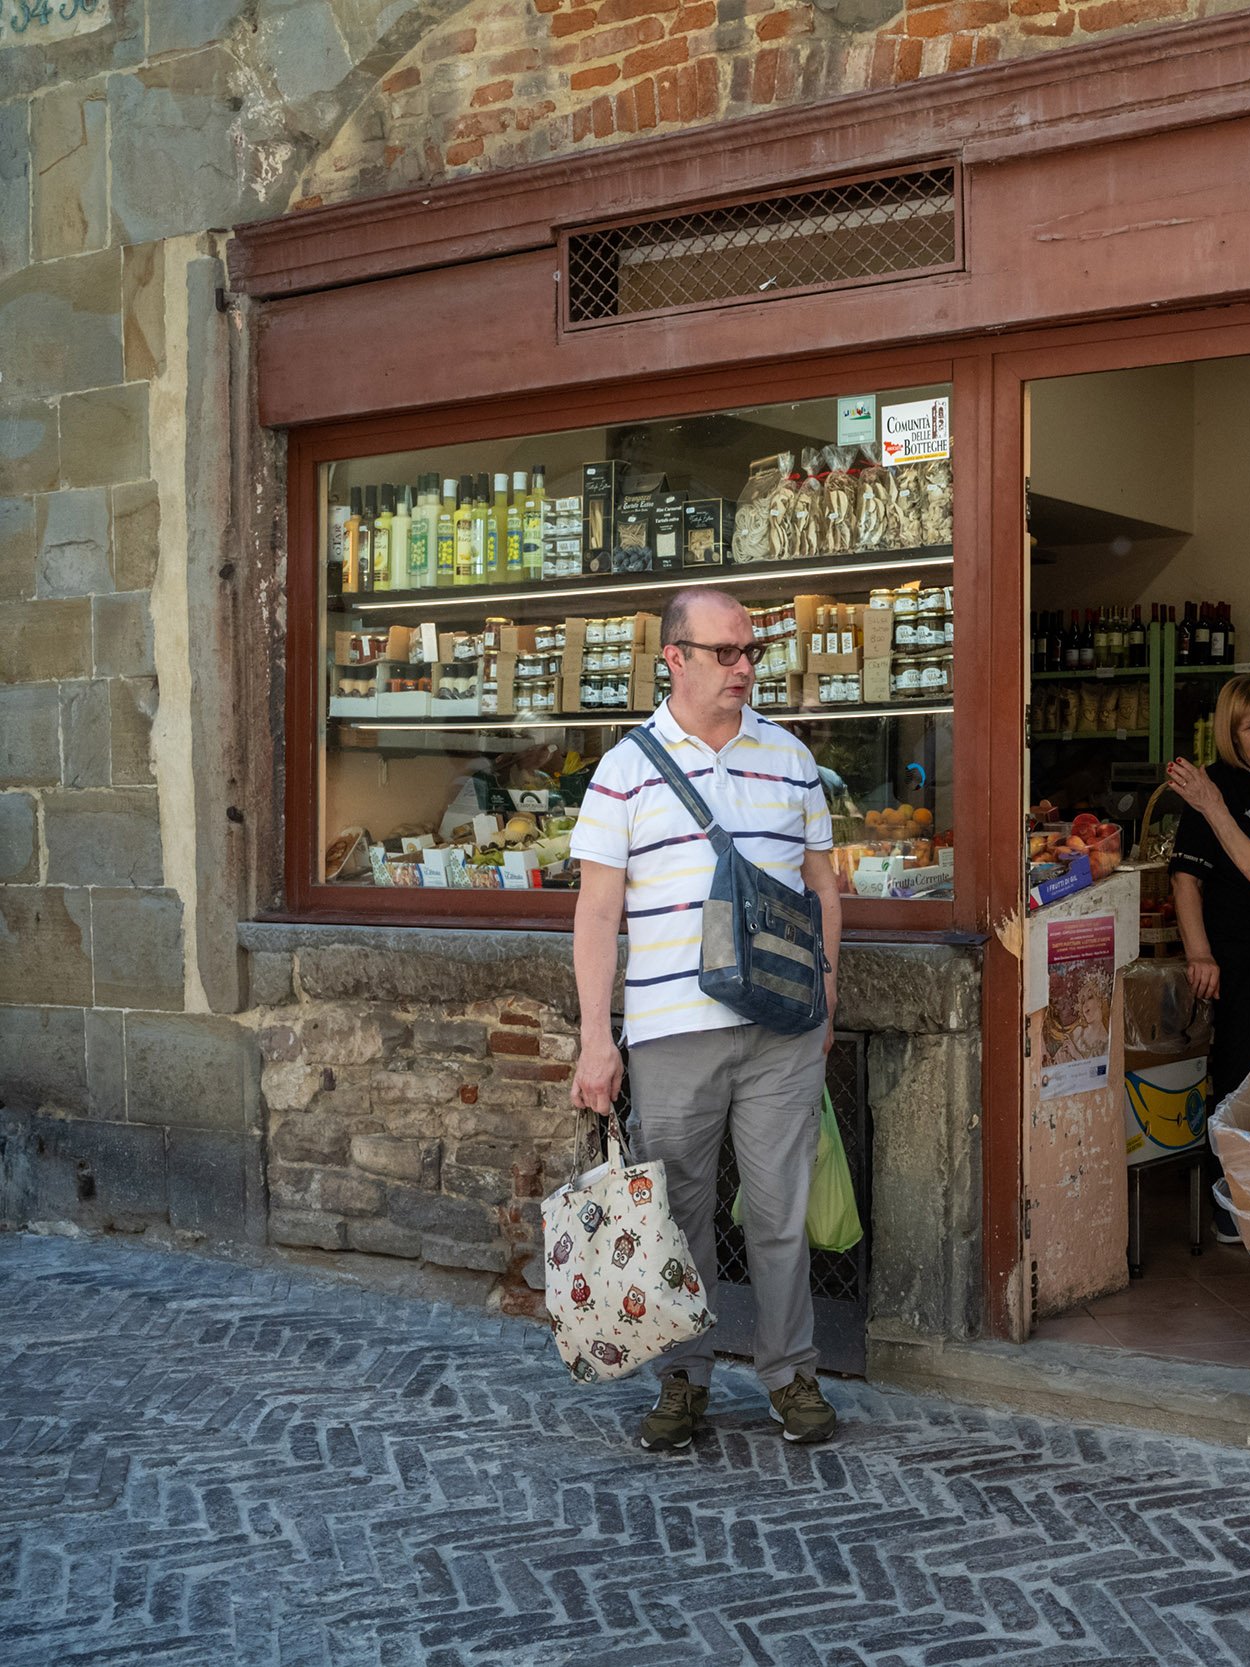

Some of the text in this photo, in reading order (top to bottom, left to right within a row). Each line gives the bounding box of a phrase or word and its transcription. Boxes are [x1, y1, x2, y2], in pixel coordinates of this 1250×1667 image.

[887, 414, 931, 434] COMUNITÀ
[912, 430, 931, 442] DELLE
[904, 439, 948, 456] BOTTEGHE
